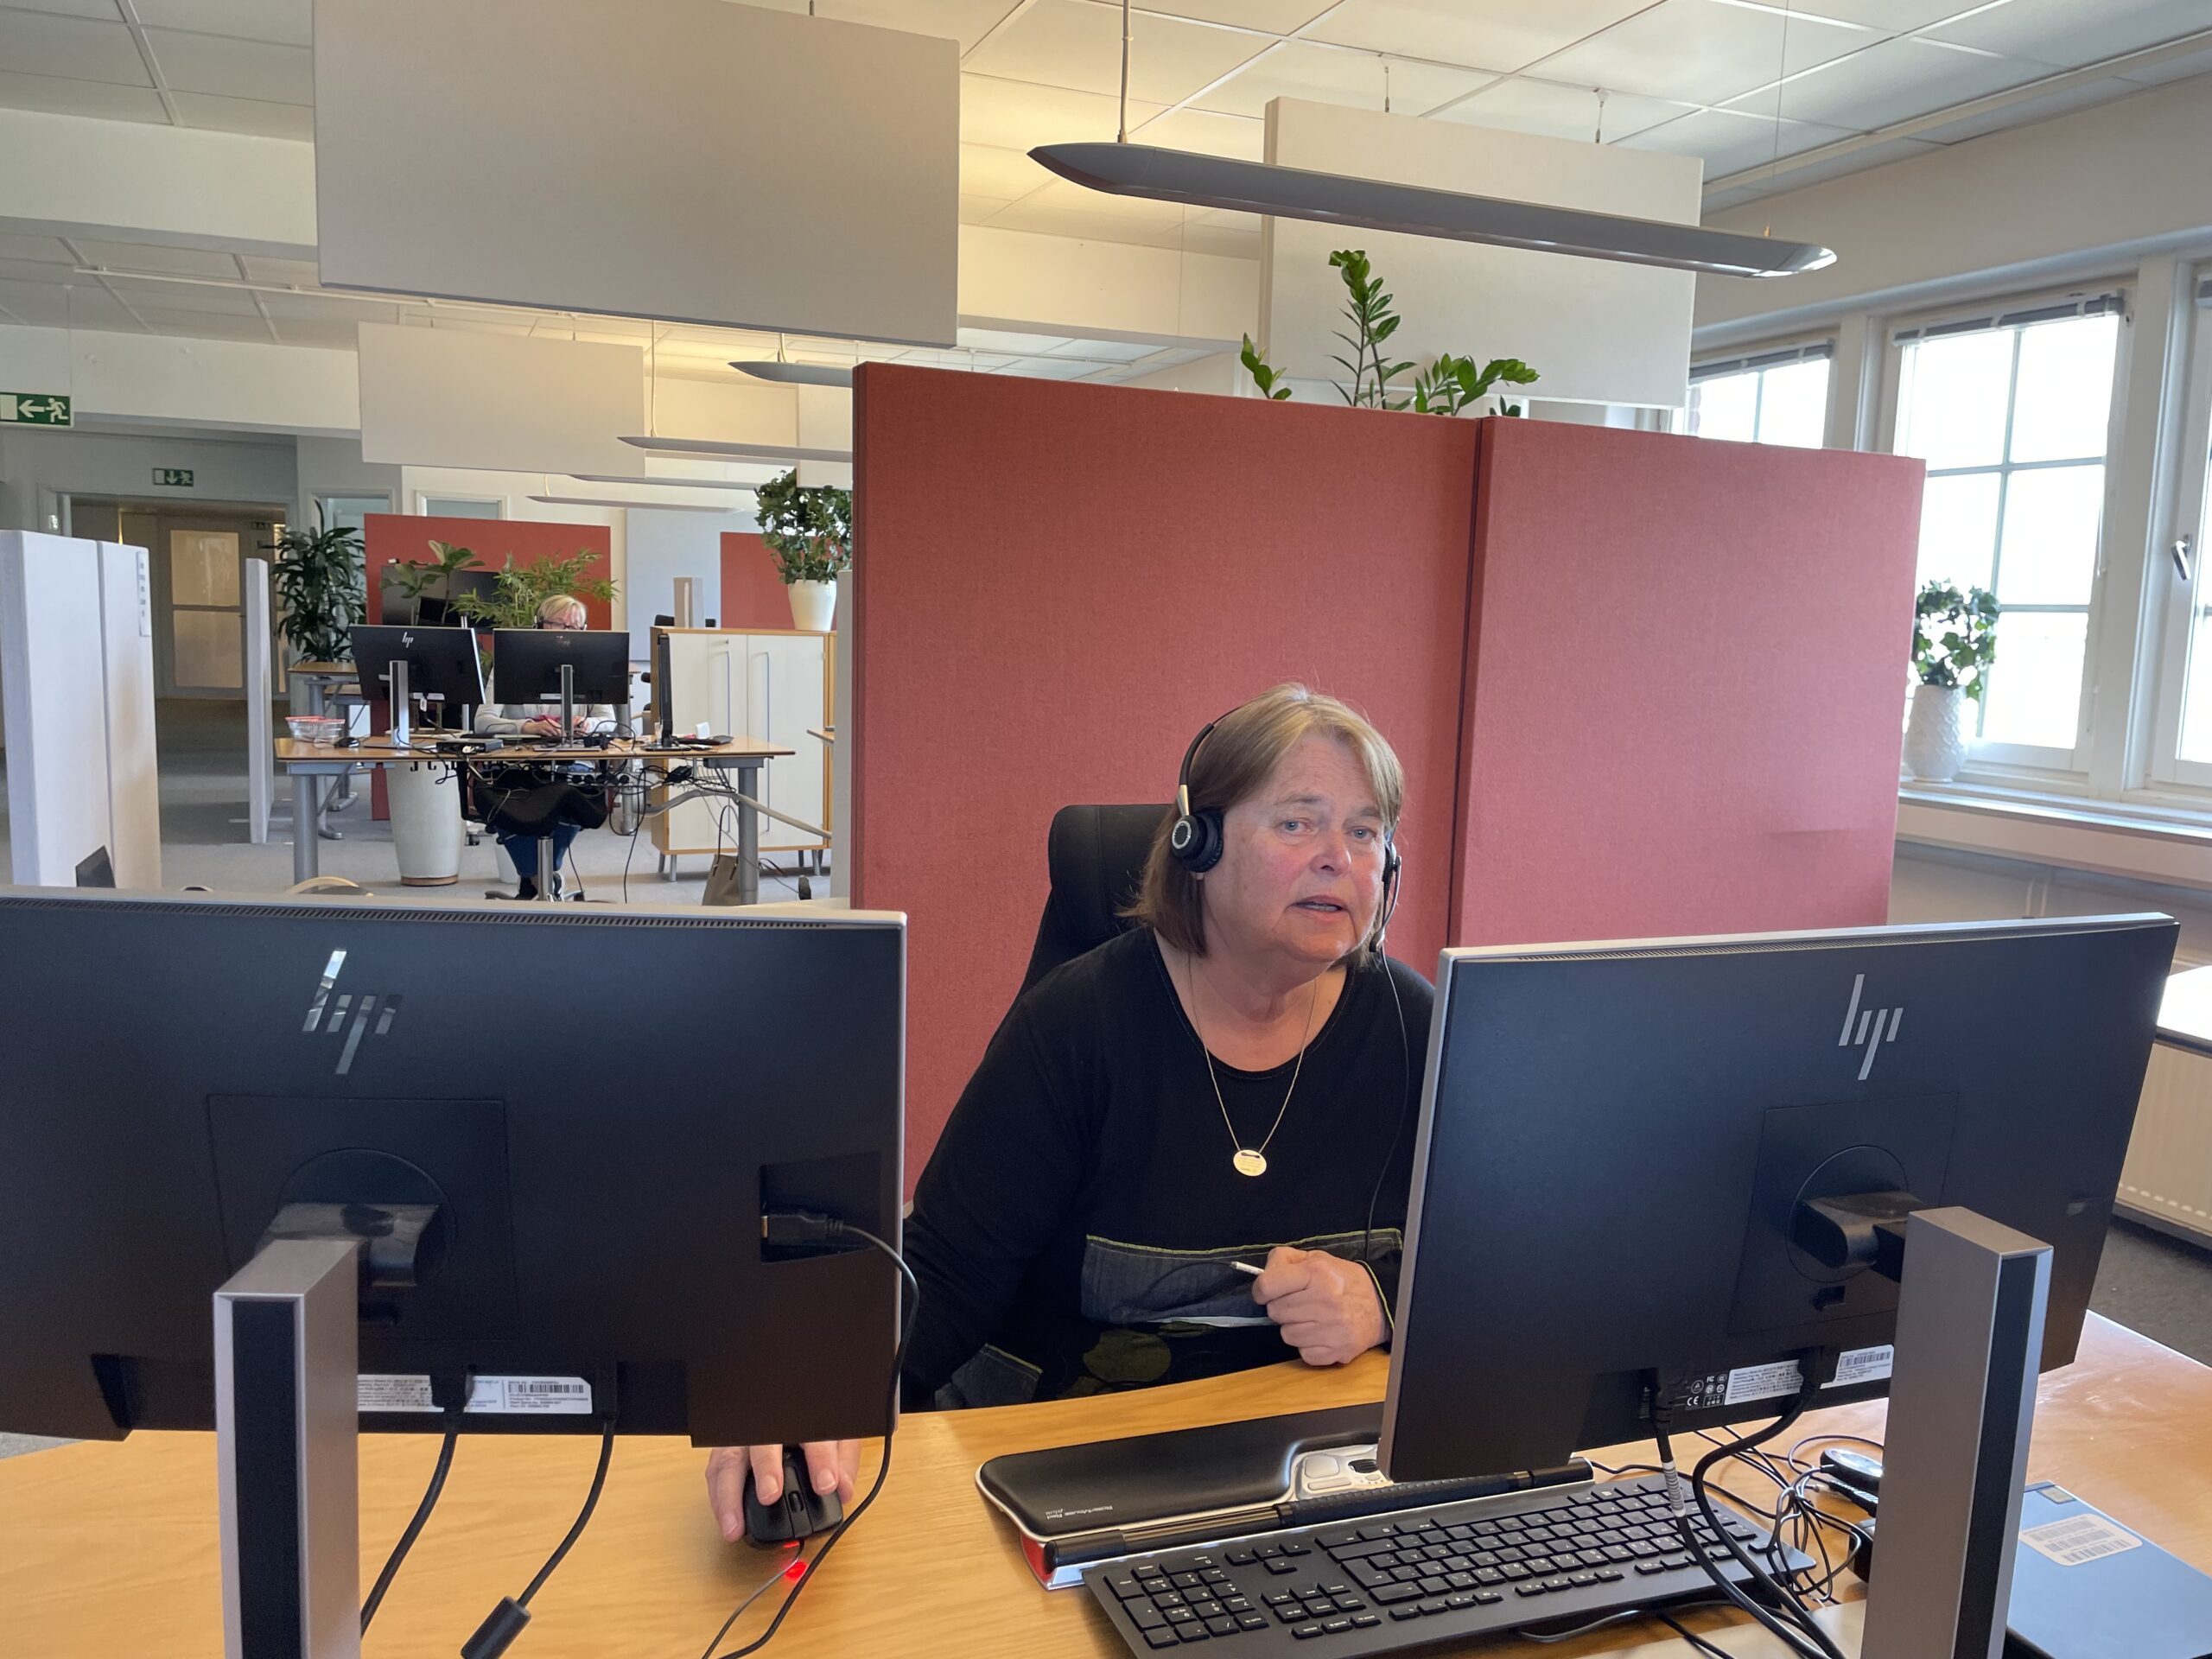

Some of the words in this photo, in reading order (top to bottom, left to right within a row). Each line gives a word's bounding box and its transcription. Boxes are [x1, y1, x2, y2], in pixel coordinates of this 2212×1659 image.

[402, 631, 414, 648] hp
[302, 950, 401, 1074] hp
[1838, 974, 1904, 1080] hp
